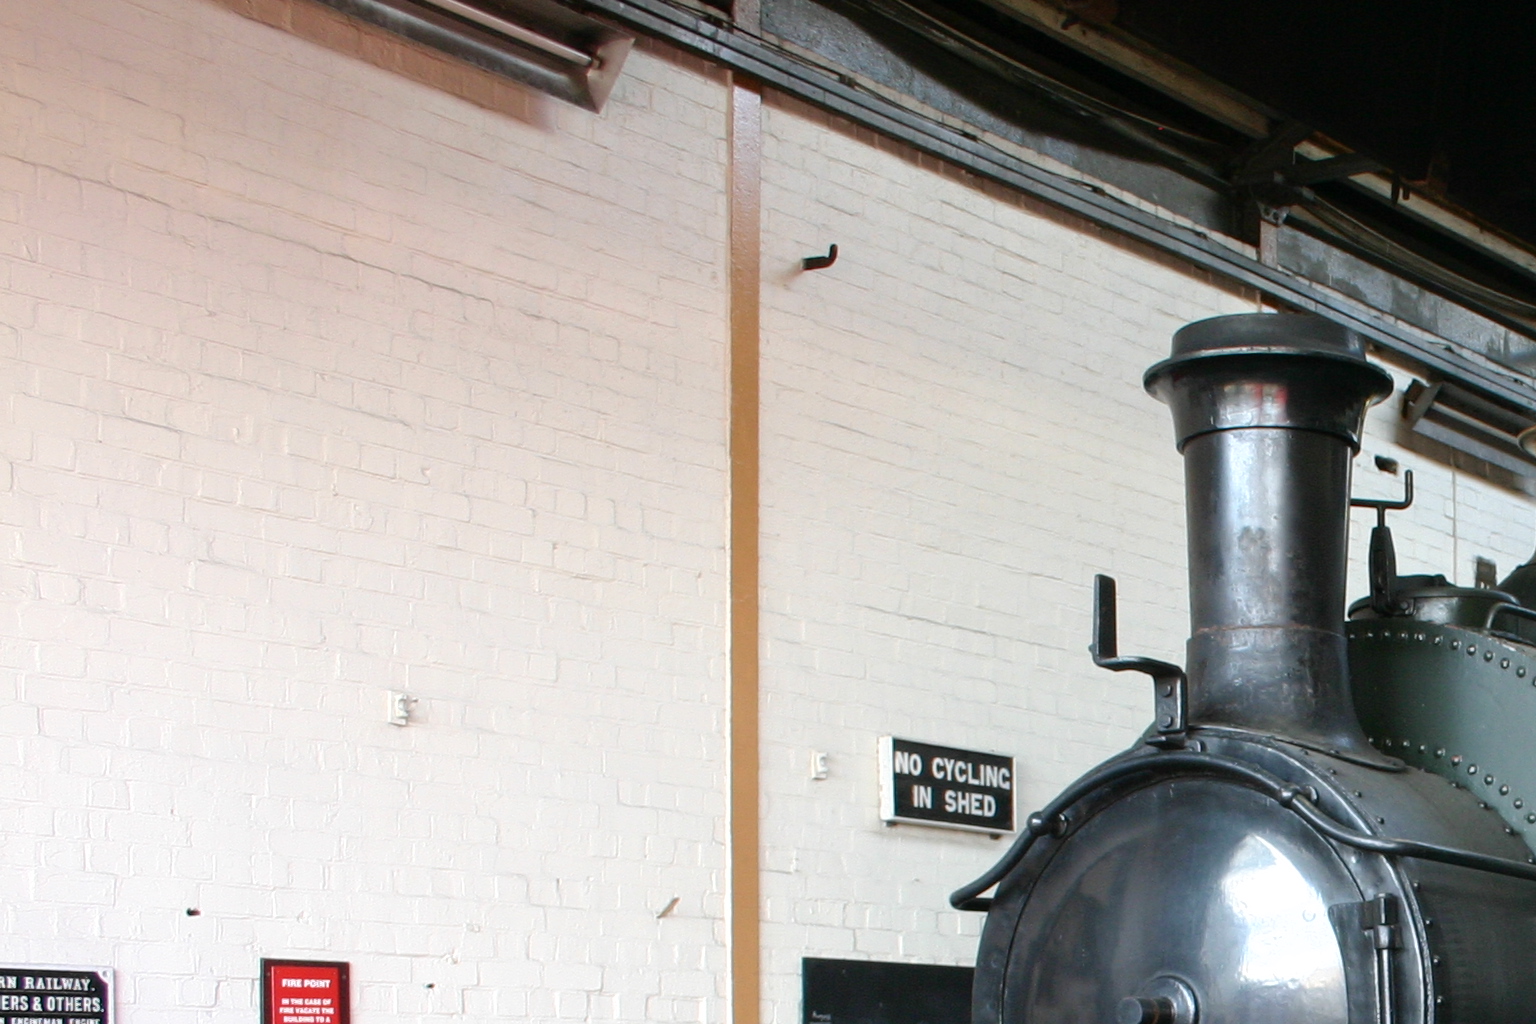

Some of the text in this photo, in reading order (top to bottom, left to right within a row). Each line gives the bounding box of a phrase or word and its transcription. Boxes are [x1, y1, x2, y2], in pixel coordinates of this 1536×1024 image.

[894, 750, 1011, 790] NO CYCLING
[912, 784, 996, 818] IN SHED
[24, 976, 96, 991] RAILWAY.
[281, 978, 331, 988] FIRE POINT
[32, 996, 43, 1011] &
[47, 996, 105, 1013] OTHERS.
